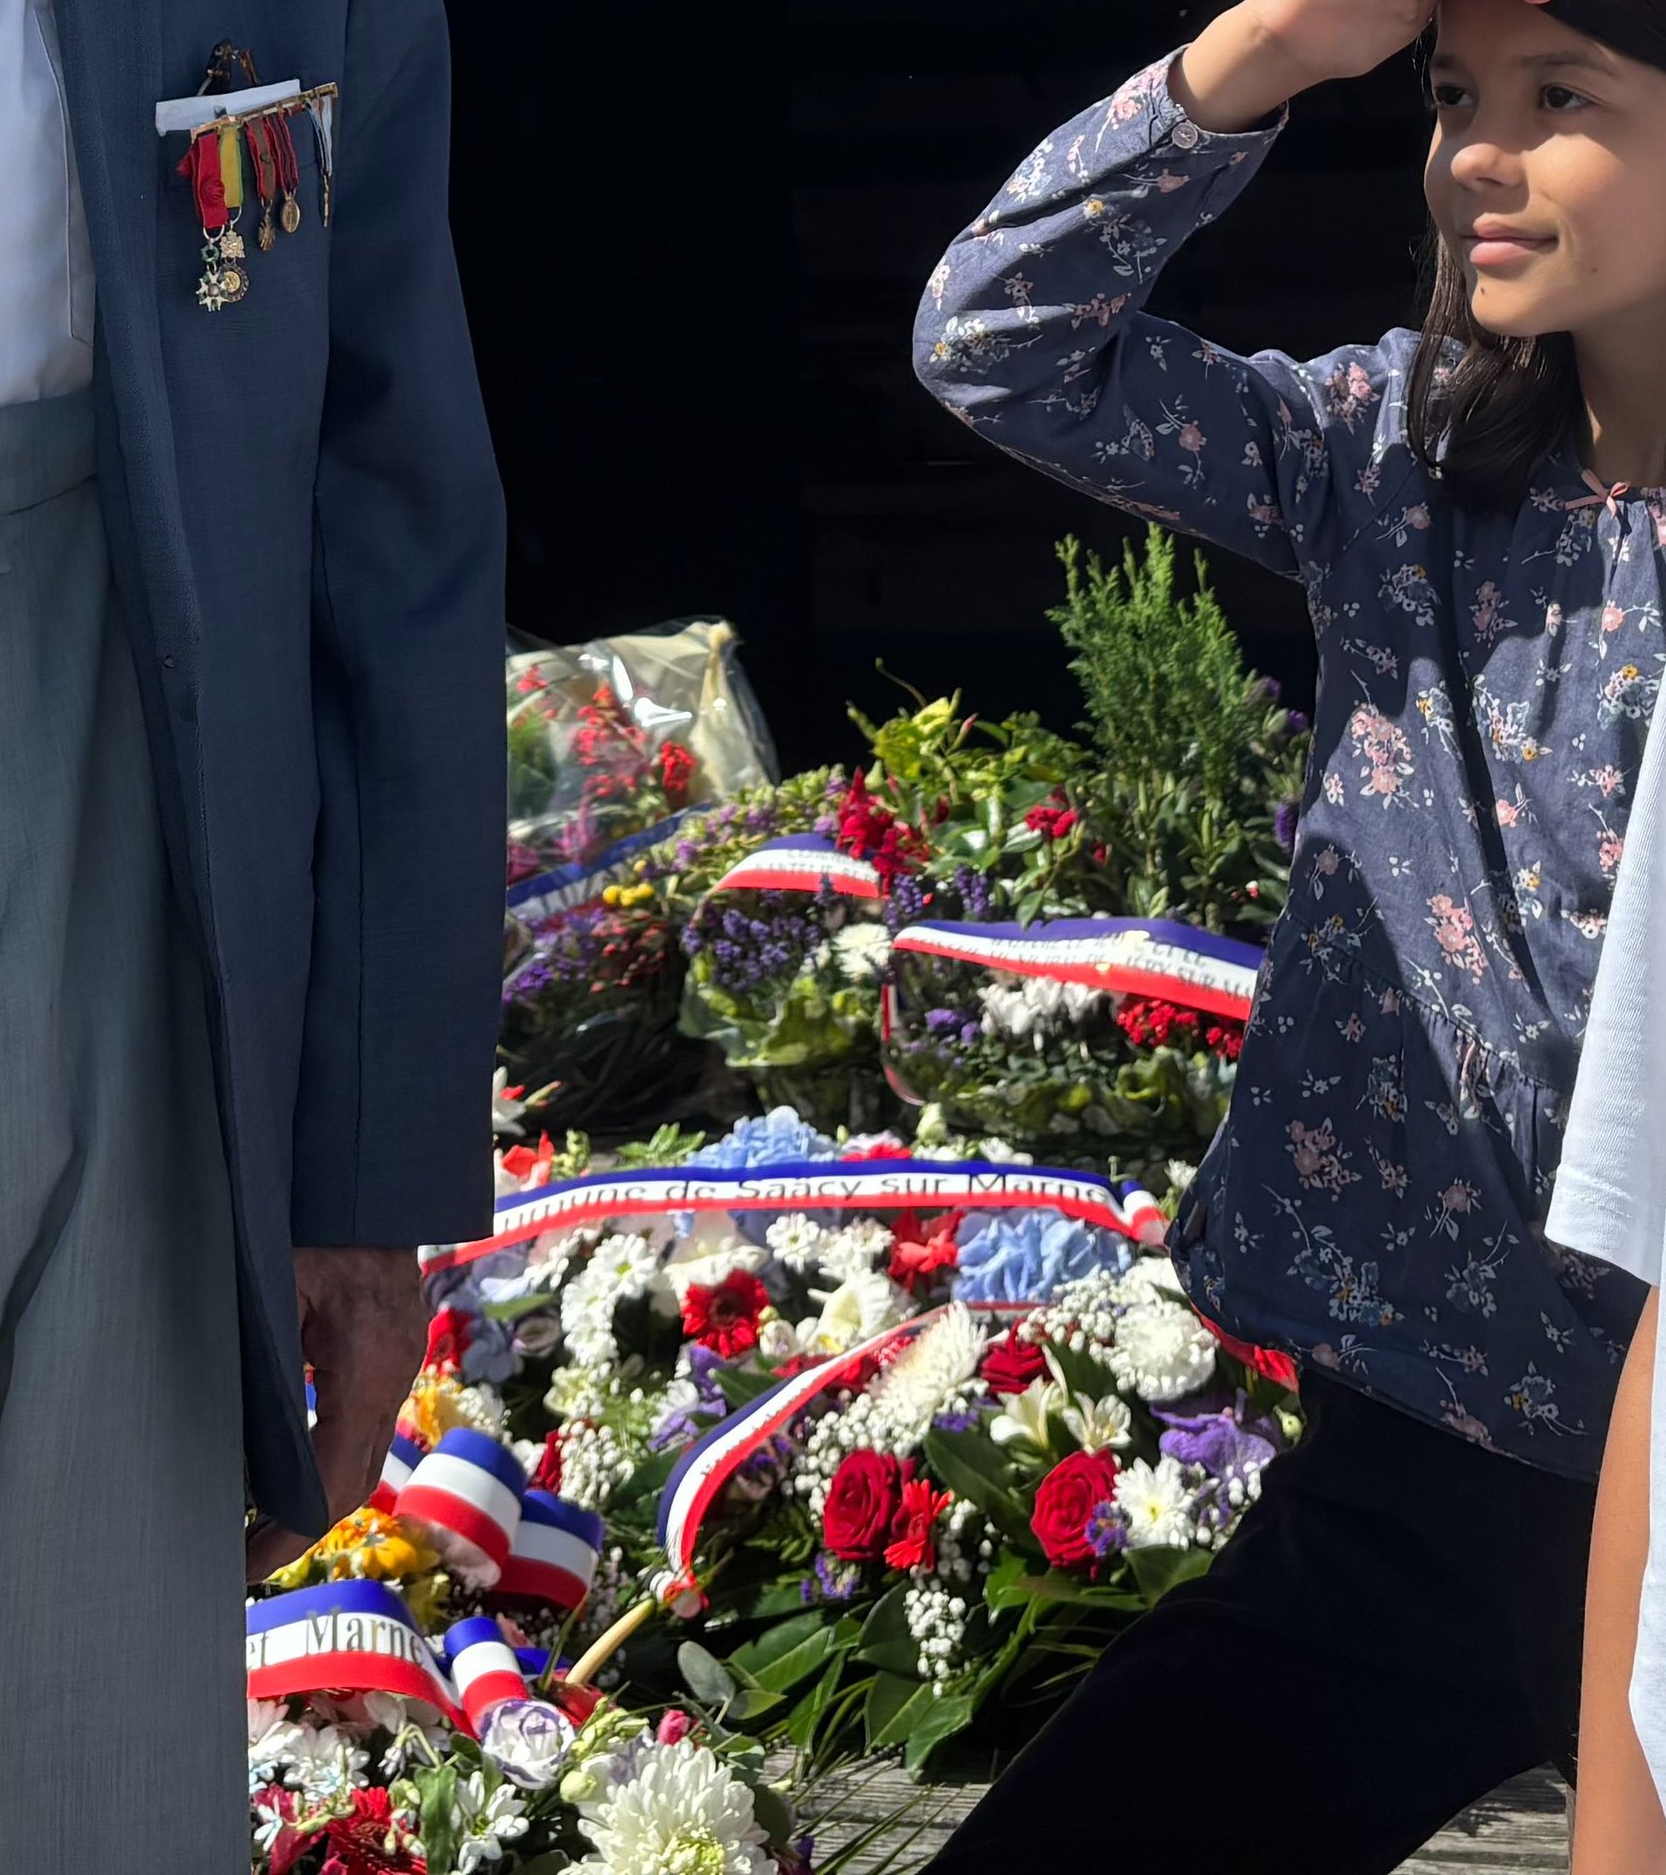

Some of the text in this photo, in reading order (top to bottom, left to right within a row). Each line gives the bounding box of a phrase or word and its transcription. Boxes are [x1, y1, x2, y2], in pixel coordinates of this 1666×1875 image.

[666, 1179, 717, 1202] de
[880, 1176, 949, 1195] sur
[968, 1172, 1110, 1204] Marne
[305, 1604, 425, 1667] Marne
